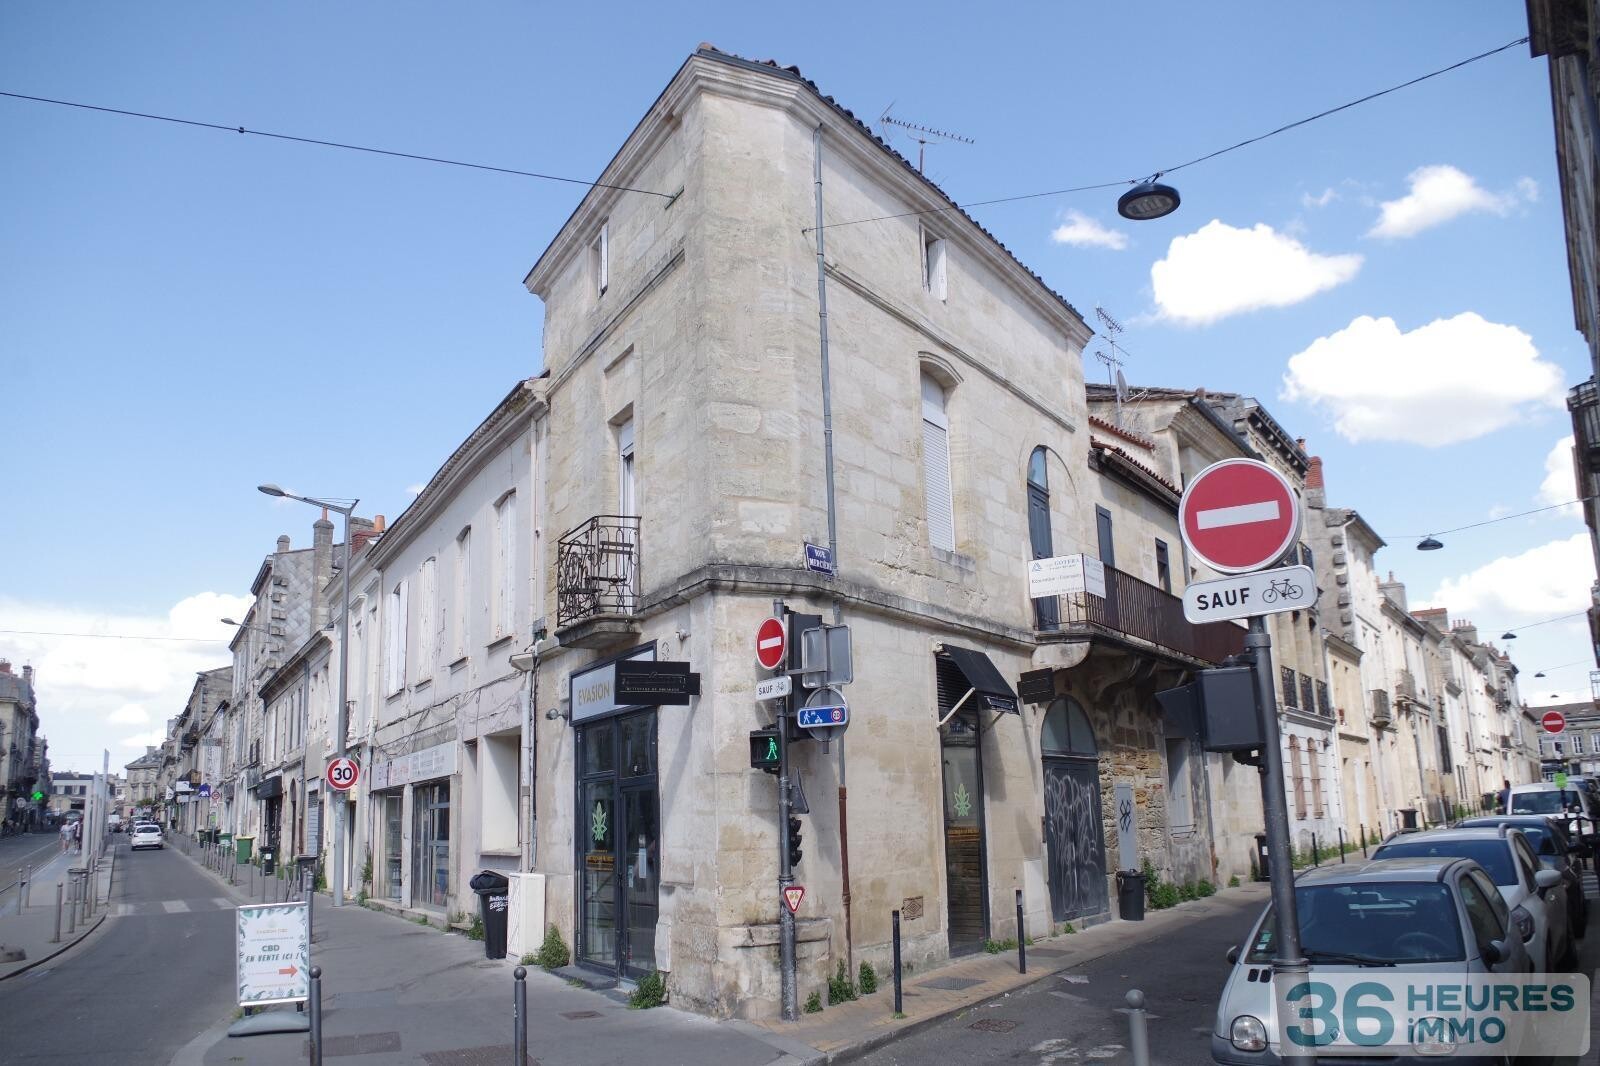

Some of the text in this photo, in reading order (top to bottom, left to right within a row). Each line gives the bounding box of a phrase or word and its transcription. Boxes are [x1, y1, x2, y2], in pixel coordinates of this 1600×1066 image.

[814, 549, 827, 559] RUE
[1196, 587, 1250, 610] SAUF
[578, 681, 610, 705] EVASION
[758, 685, 773, 695] SAUF
[334, 767, 352, 780] 30
[261, 944, 280, 952] CBD
[245, 954, 255, 963] EN
[258, 953, 280, 962] VENTE
